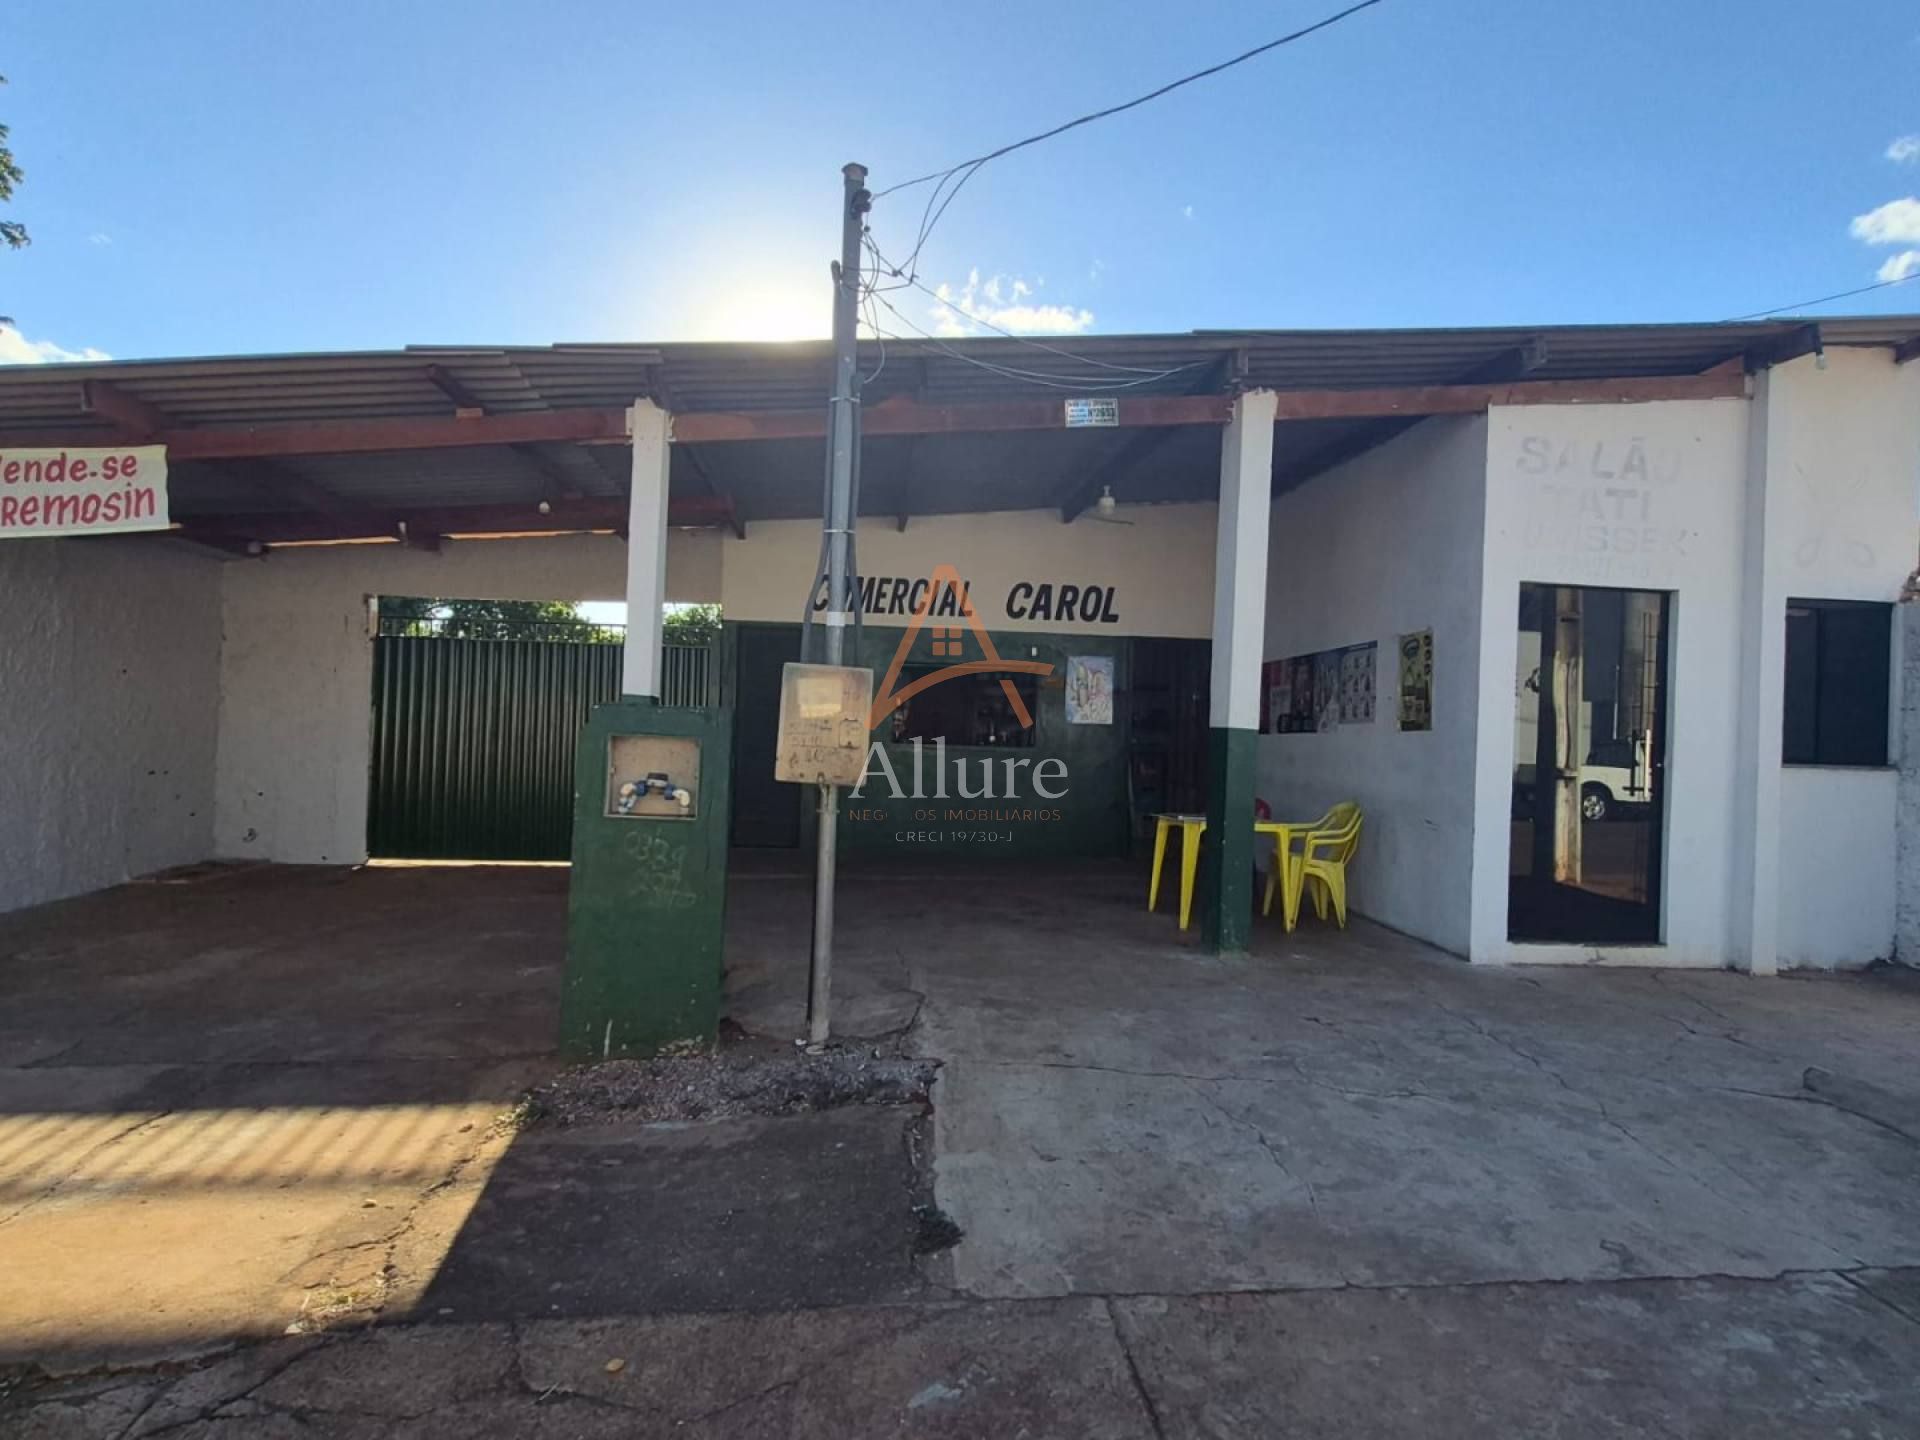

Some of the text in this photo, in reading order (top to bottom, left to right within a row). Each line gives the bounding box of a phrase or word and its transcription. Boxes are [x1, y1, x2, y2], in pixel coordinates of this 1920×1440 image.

[0, 452, 137, 484] ende-se
[812, 574, 1120, 623] CMERCIAL CAROL
